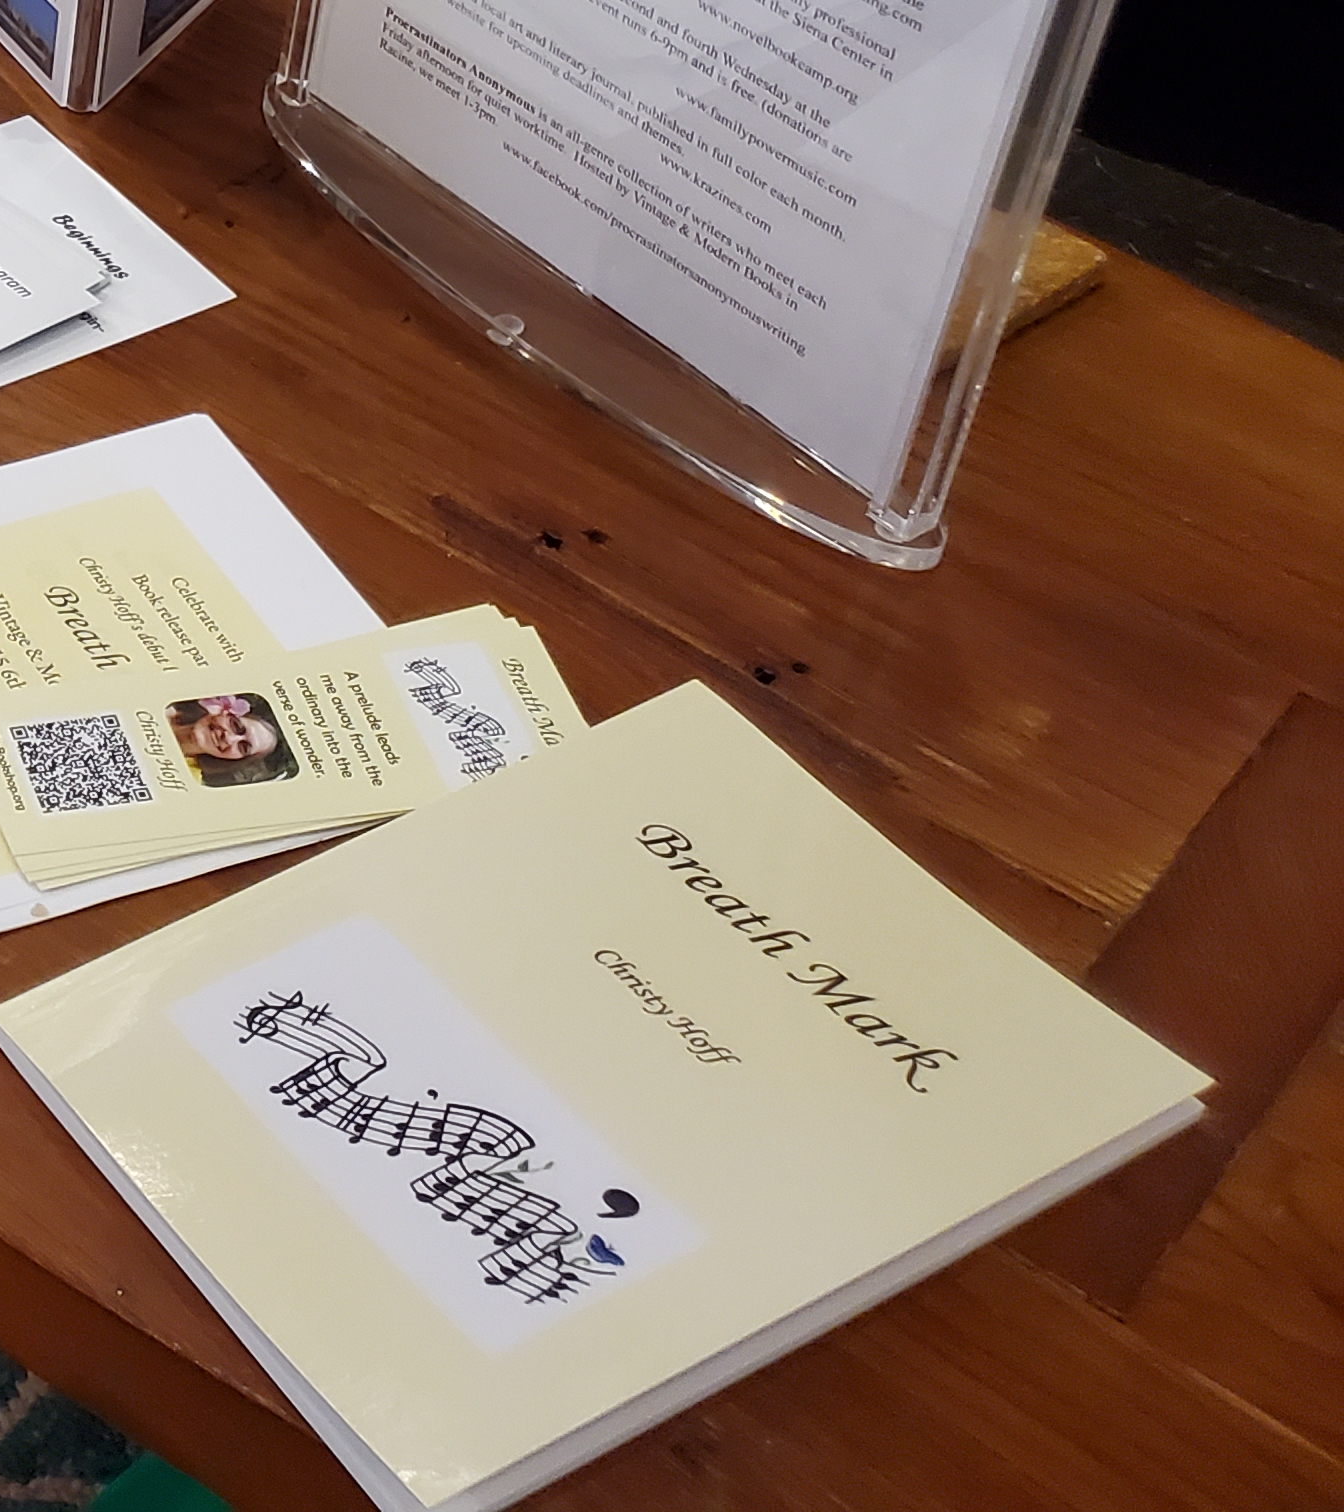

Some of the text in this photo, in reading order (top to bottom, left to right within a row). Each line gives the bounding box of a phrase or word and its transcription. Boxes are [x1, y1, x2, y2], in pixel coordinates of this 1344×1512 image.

[659, 151, 772, 235] www.krazines.com
[674, 86, 857, 208] www.familypowermusic.com
[52, 214, 130, 280] Beginnings
[24, 647, 43, 663] &
[42, 585, 131, 670] Breath
[77, 556, 170, 664] Christy Hoff's debut
[130, 572, 210, 667] Book release par
[170, 576, 245, 663] Celebrate with
[271, 679, 326, 779] verse of wonder.
[295, 676, 353, 779] ordinary into the
[318, 673, 383, 787] me away from the
[342, 670, 401, 766] A prelude leads
[501, 656, 541, 718] Breath
[134, 709, 189, 792] Christy Hoff
[593, 948, 742, 1064] Christy Hoff
[634, 823, 959, 1094] Breath Mark
